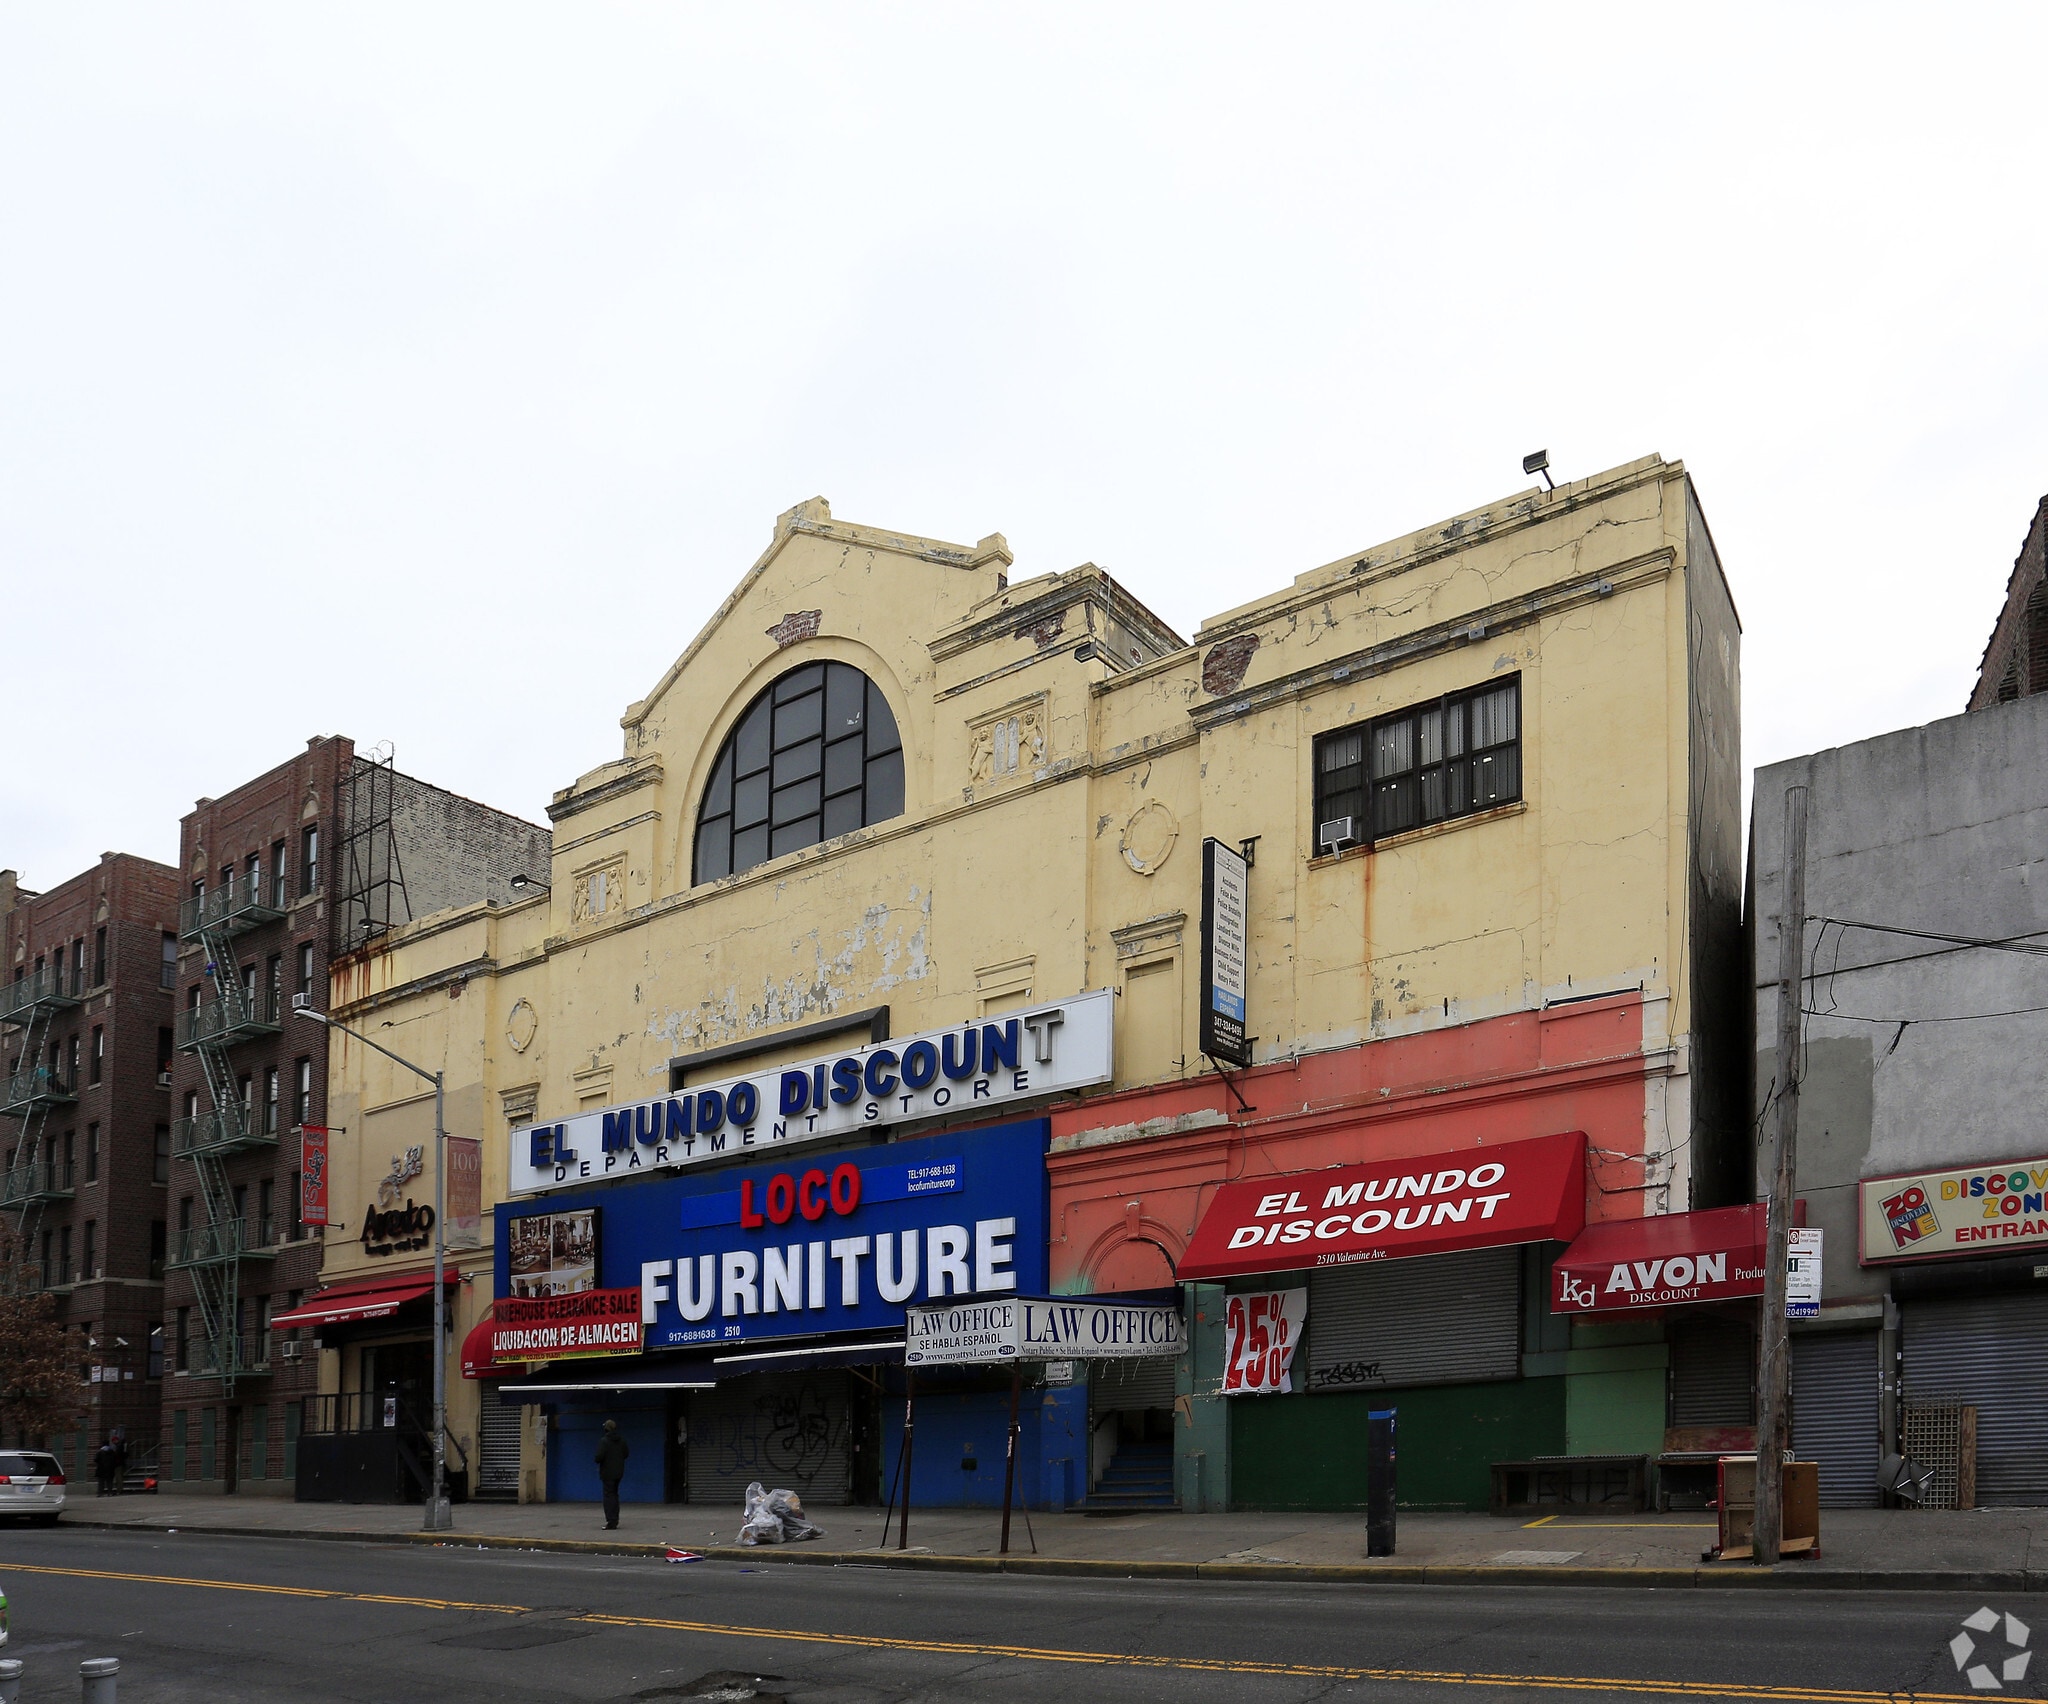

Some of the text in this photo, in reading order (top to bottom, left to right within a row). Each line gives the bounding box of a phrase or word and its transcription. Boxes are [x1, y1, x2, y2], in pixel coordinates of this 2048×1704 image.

[1217, 897, 1228, 910] Police
[1219, 911, 1239, 929] Immigration
[1217, 960, 1240, 978] Child Support
[1217, 972, 1240, 990] Notary Public
[530, 1009, 1064, 1167] EL MUNDO DISCOUNT
[555, 1070, 1029, 1182] DEPARTMENT STORE
[452, 1152, 478, 1171] 100
[740, 1162, 862, 1229] LOCO
[1254, 1163, 1506, 1218] EL MUNDO
[1941, 1168, 2048, 1201] DISCOV
[1227, 1192, 1511, 1250] DISCOUNT
[1890, 1204, 1931, 1229] DISCOVERY
[1955, 1219, 2048, 1243] ENTRAN
[1316, 1249, 1387, 1265] 2510 Valentine Ave.
[1791, 1259, 1795, 1272] 1
[641, 1217, 1017, 1325] FURNITURE
[1559, 1271, 1596, 1307] kd
[1604, 1252, 1727, 1293] AVON
[548, 1296, 606, 1319] CLEARANCE
[609, 1294, 637, 1315] SALE
[1629, 1288, 1700, 1304] DISCOUNT
[910, 1305, 1013, 1337] LAW OFFICE
[1786, 1308, 1811, 1316] 204199
[494, 1322, 638, 1351] LIQUIDACION DE ALMACEN
[724, 1326, 741, 1337] 2510
[1024, 1305, 1180, 1345] LAW OFFICE
[920, 1332, 1002, 1350] SE HABLA ESPAÑOL
[1021, 1345, 1039, 1357] Notary
[1039, 1345, 1055, 1355] Public
[1060, 1346, 1066, 1355] Se
[1067, 1346, 1081, 1355] Habla
[1225, 1293, 1288, 1390] 25%
[925, 1349, 997, 1361] www.myattys1.com
[1000, 1346, 1014, 1354] 2510
